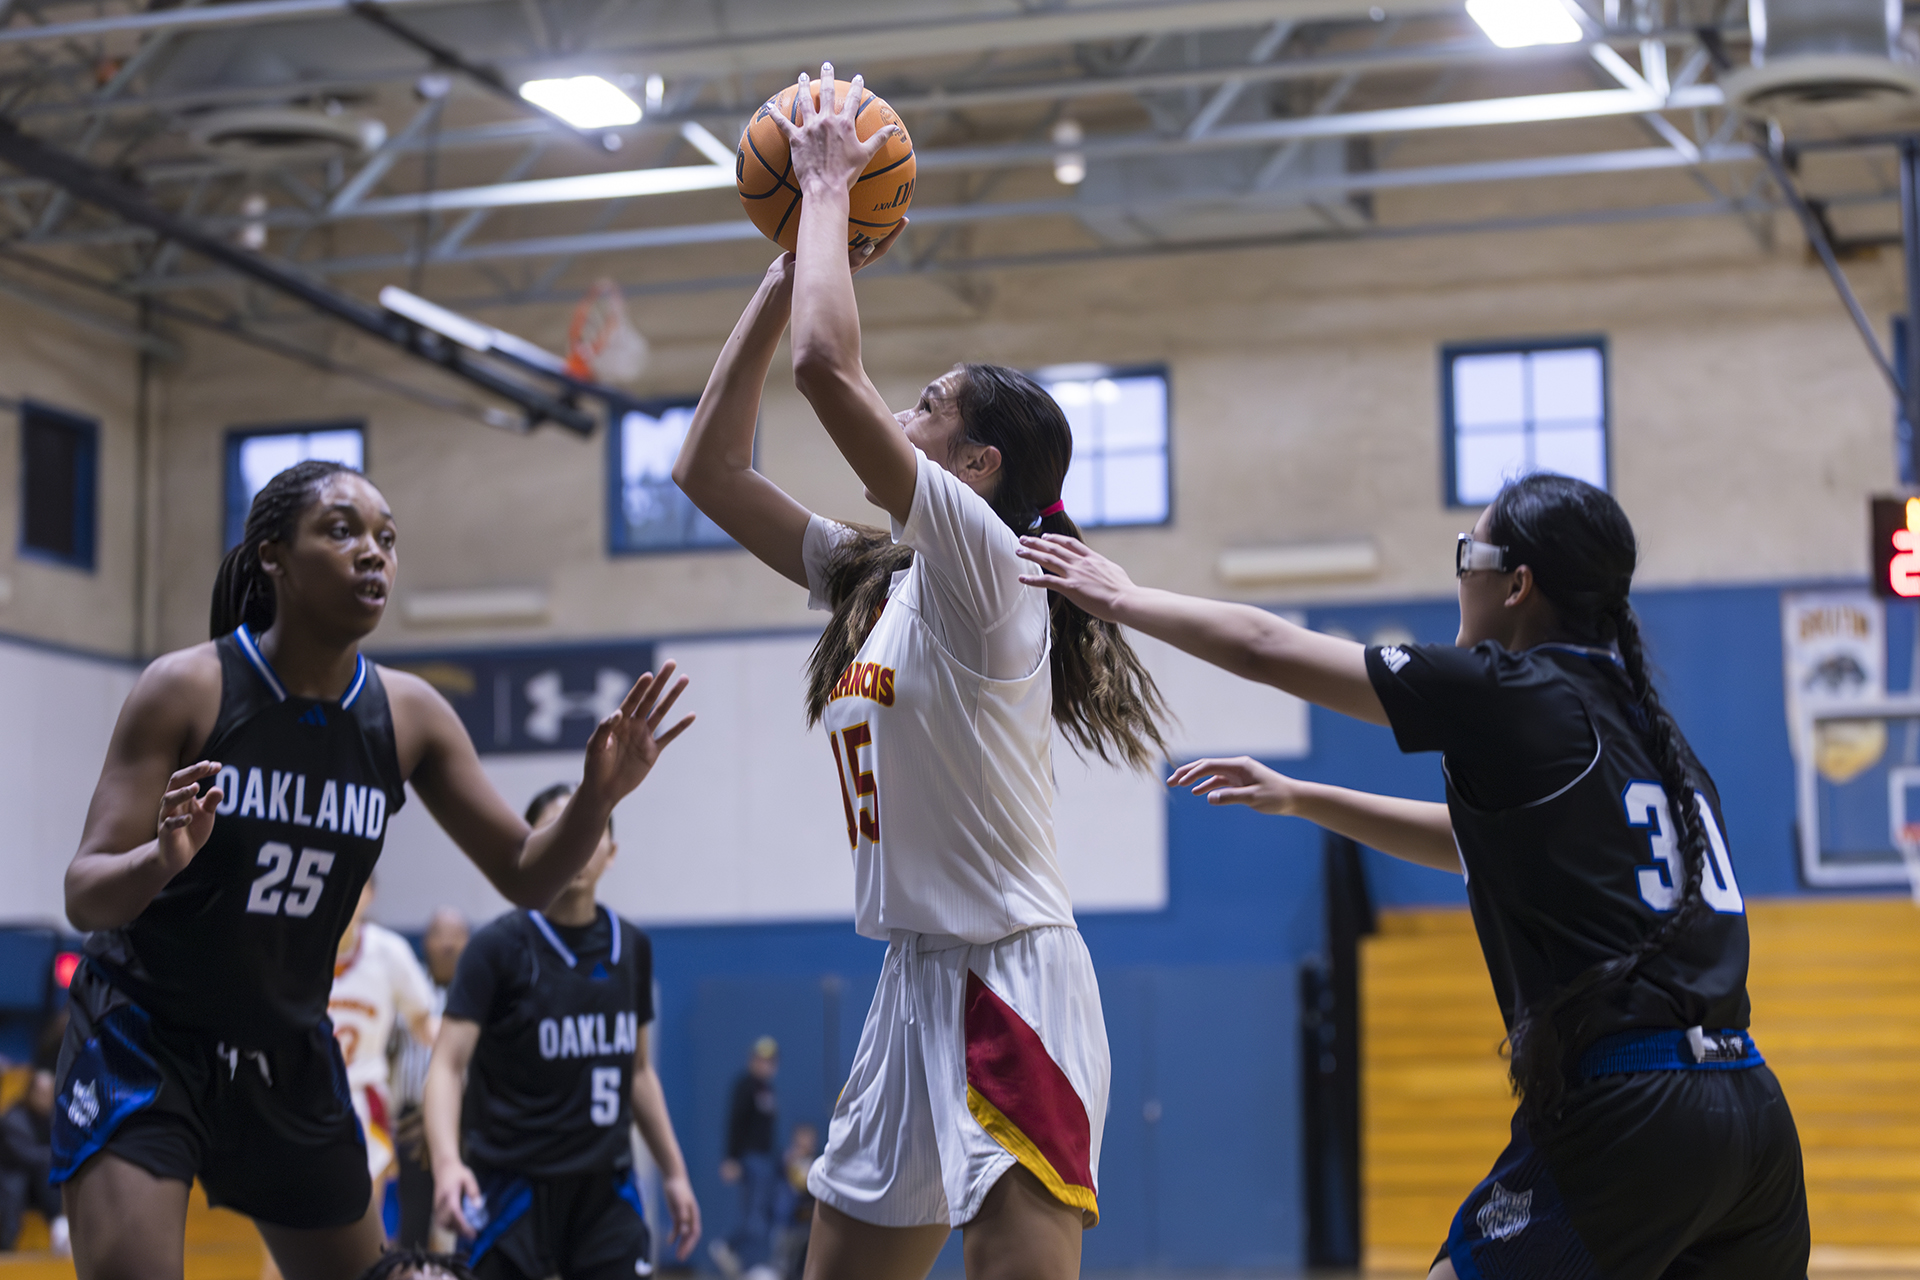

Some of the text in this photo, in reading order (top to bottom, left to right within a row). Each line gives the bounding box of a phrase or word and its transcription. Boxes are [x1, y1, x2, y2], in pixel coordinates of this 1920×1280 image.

[826, 661, 896, 708] ANCIS
[215, 764, 387, 841] OAKLAND
[830, 720, 880, 850] 15
[246, 839, 336, 918] 25
[1621, 777, 1745, 916] 30
[590, 1066, 622, 1127] 5
